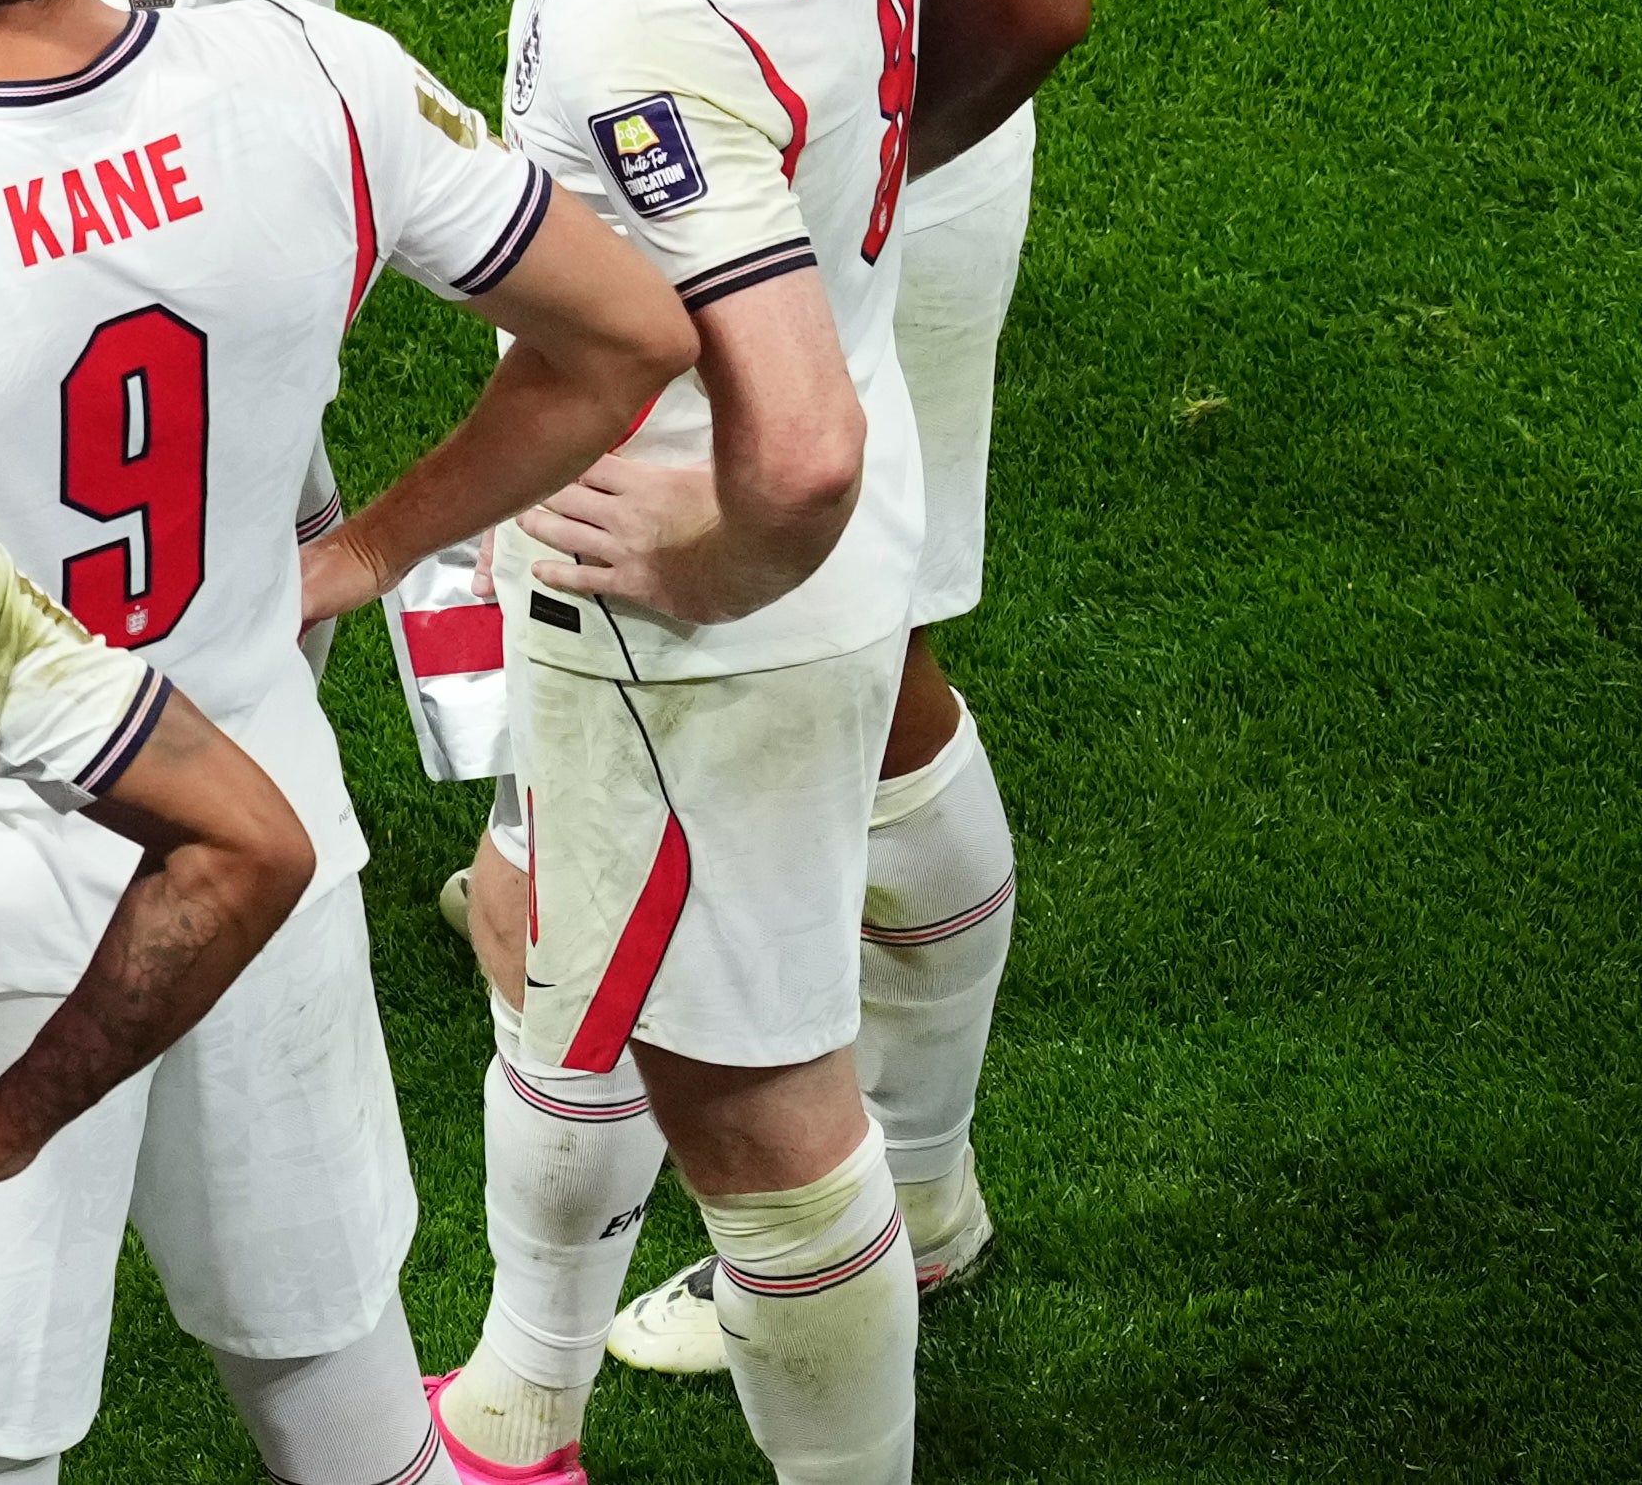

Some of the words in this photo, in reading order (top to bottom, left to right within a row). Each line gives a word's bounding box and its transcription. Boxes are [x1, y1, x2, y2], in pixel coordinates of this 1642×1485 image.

[3, 133, 203, 268] KANE
[643, 190, 669, 206] FIFA
[61, 303, 208, 648] 9
